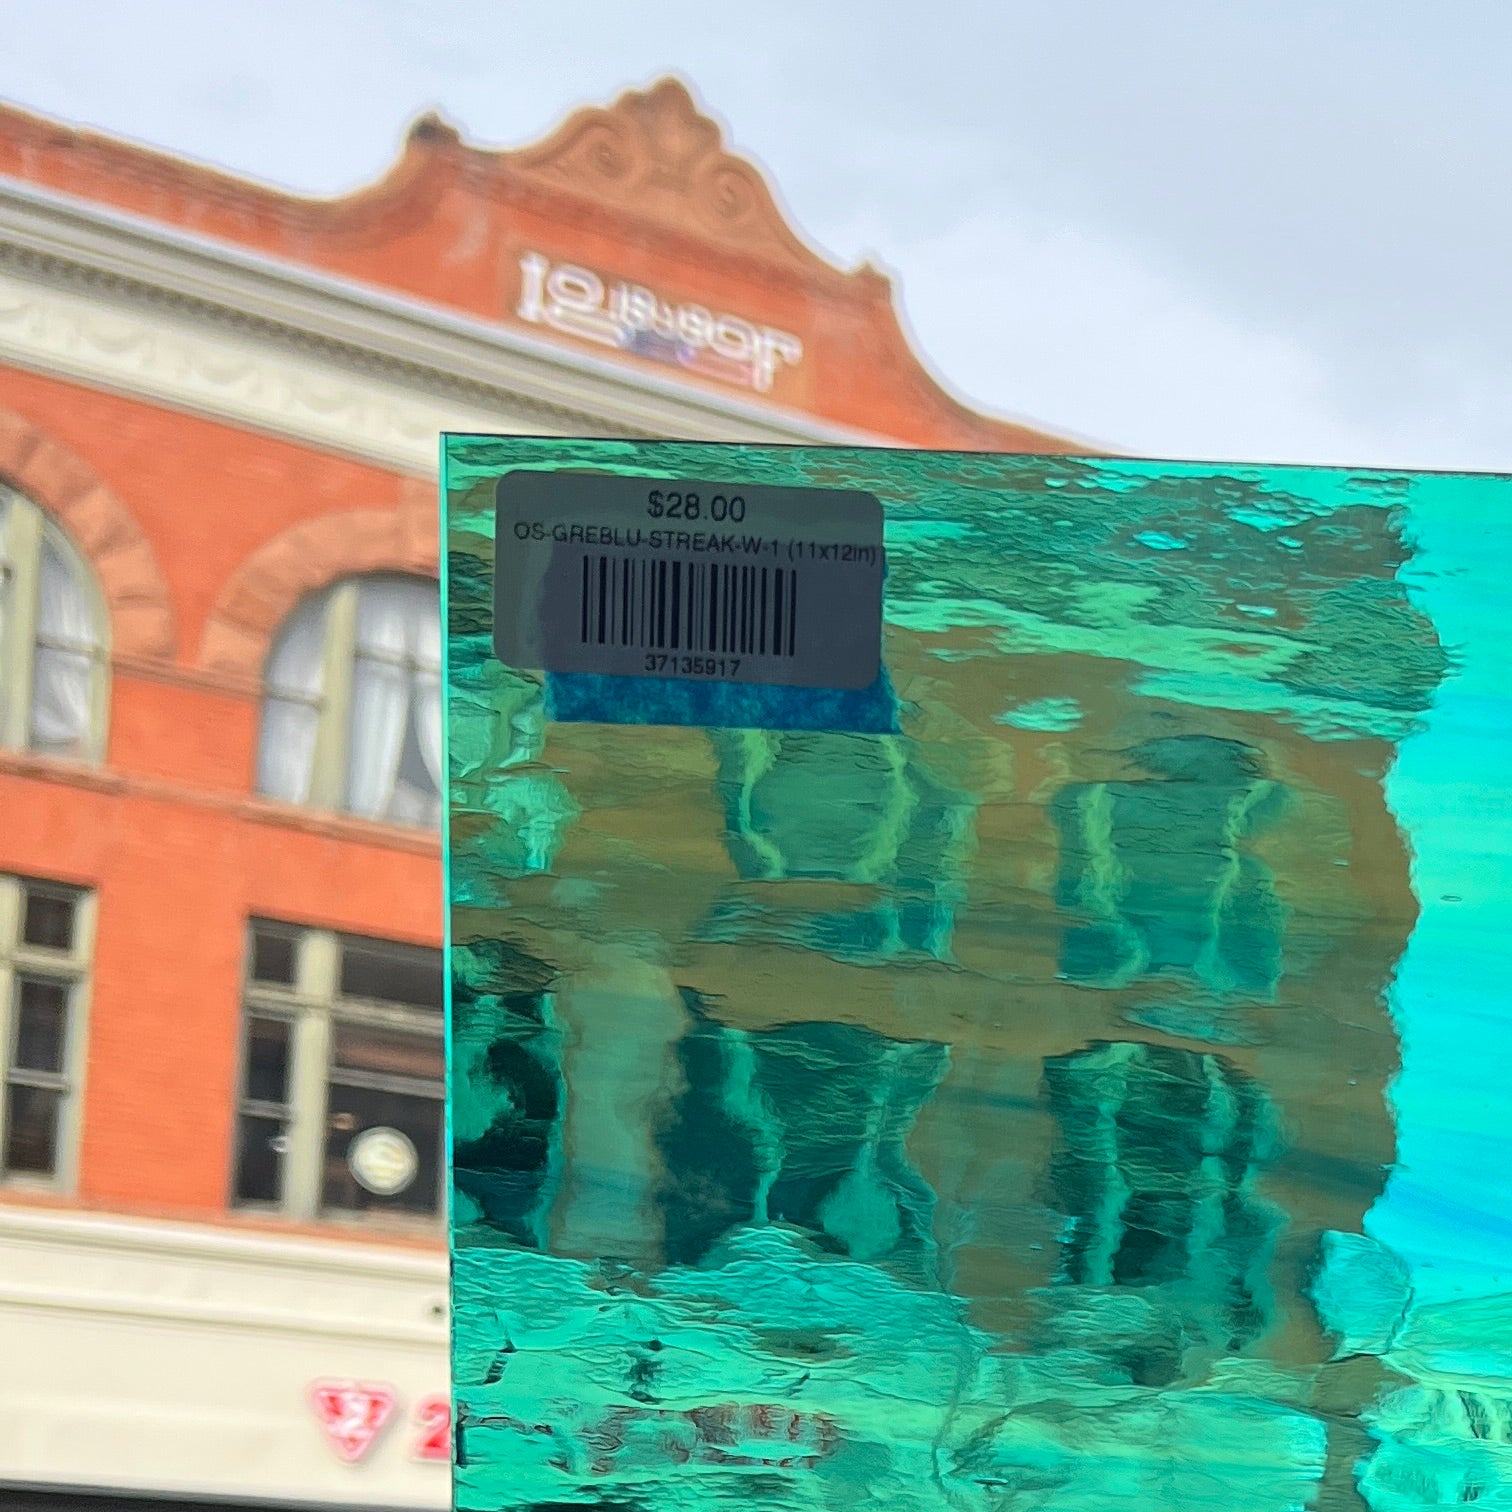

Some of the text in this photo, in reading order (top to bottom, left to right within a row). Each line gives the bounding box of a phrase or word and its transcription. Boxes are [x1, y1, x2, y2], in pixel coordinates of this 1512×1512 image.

[647, 489, 746, 523] $28.00
[513, 521, 877, 567] OS-GREBLU-STREAK-W-1 (11x12in)
[644, 653, 741, 677] 37135917
